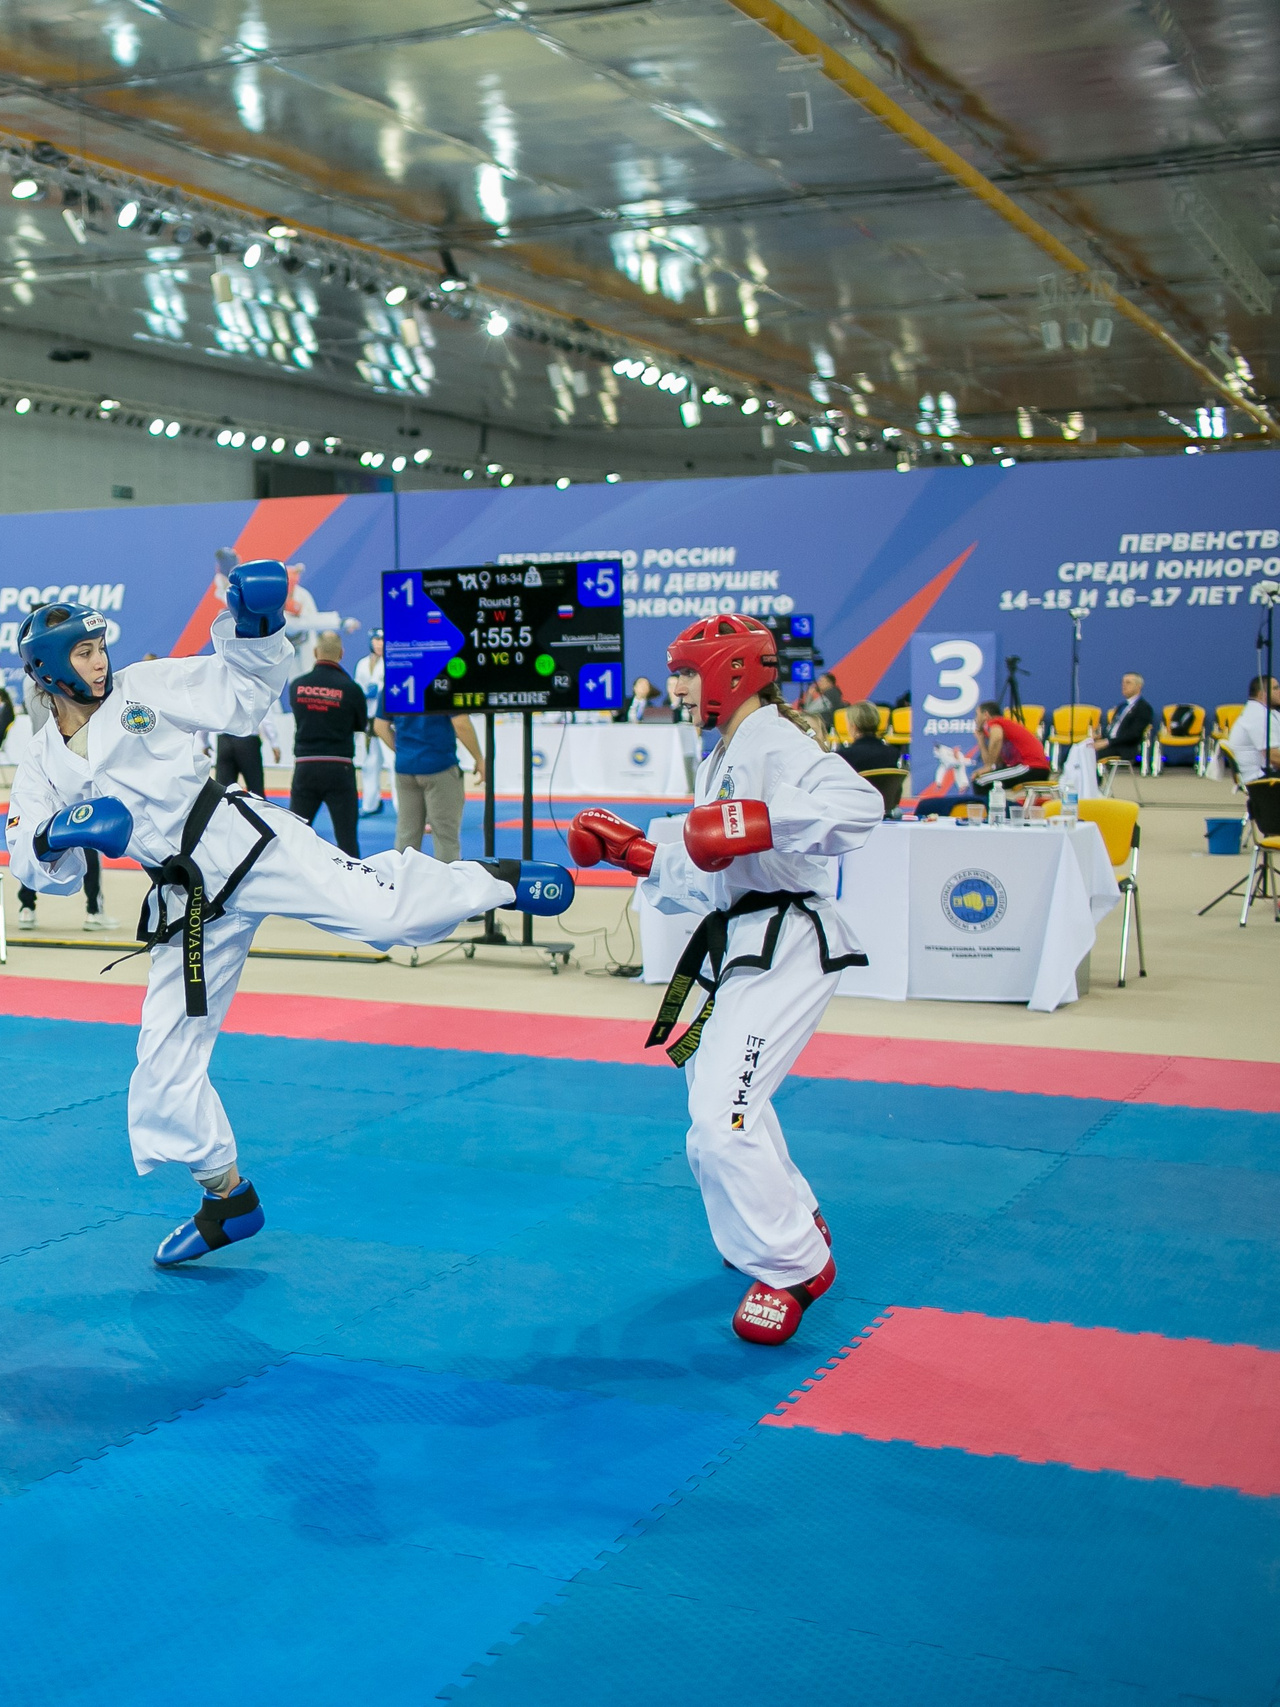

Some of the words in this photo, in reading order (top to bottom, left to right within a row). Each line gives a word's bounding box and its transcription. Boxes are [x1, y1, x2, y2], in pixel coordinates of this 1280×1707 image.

[642, 547, 736, 568] РОССИИ
[583, 567, 615, 598] +5
[643, 573, 662, 594] И
[663, 569, 780, 596] ДЕВУШЕК
[1058, 560, 1148, 585] СРЕДИ
[387, 577, 414, 607] +1
[479, 596, 511, 608] Round
[513, 595, 521, 607] 2
[1078, 587, 1098, 609] И
[1187, 585, 1244, 606] ЛЕТ
[741, 593, 795, 616] ИТФ
[477, 611, 485, 623] 2
[494, 610, 506, 622] W
[515, 609, 523, 622] 2
[470, 626, 532, 648] 1:55.5
[477, 653, 486, 665] 0
[491, 651, 510, 665] YC
[515, 651, 524, 664] 0
[390, 674, 416, 704] +1
[434, 678, 449, 690] R2
[554, 675, 569, 687] R2
[585, 669, 613, 700] +1
[922, 640, 983, 718] 3
[296, 686, 343, 701] РОССИЯ
[188, 886, 203, 949] DUBOVA
[746, 1034, 766, 1049] ITF
[745, 1314, 778, 1330] FIGHT
